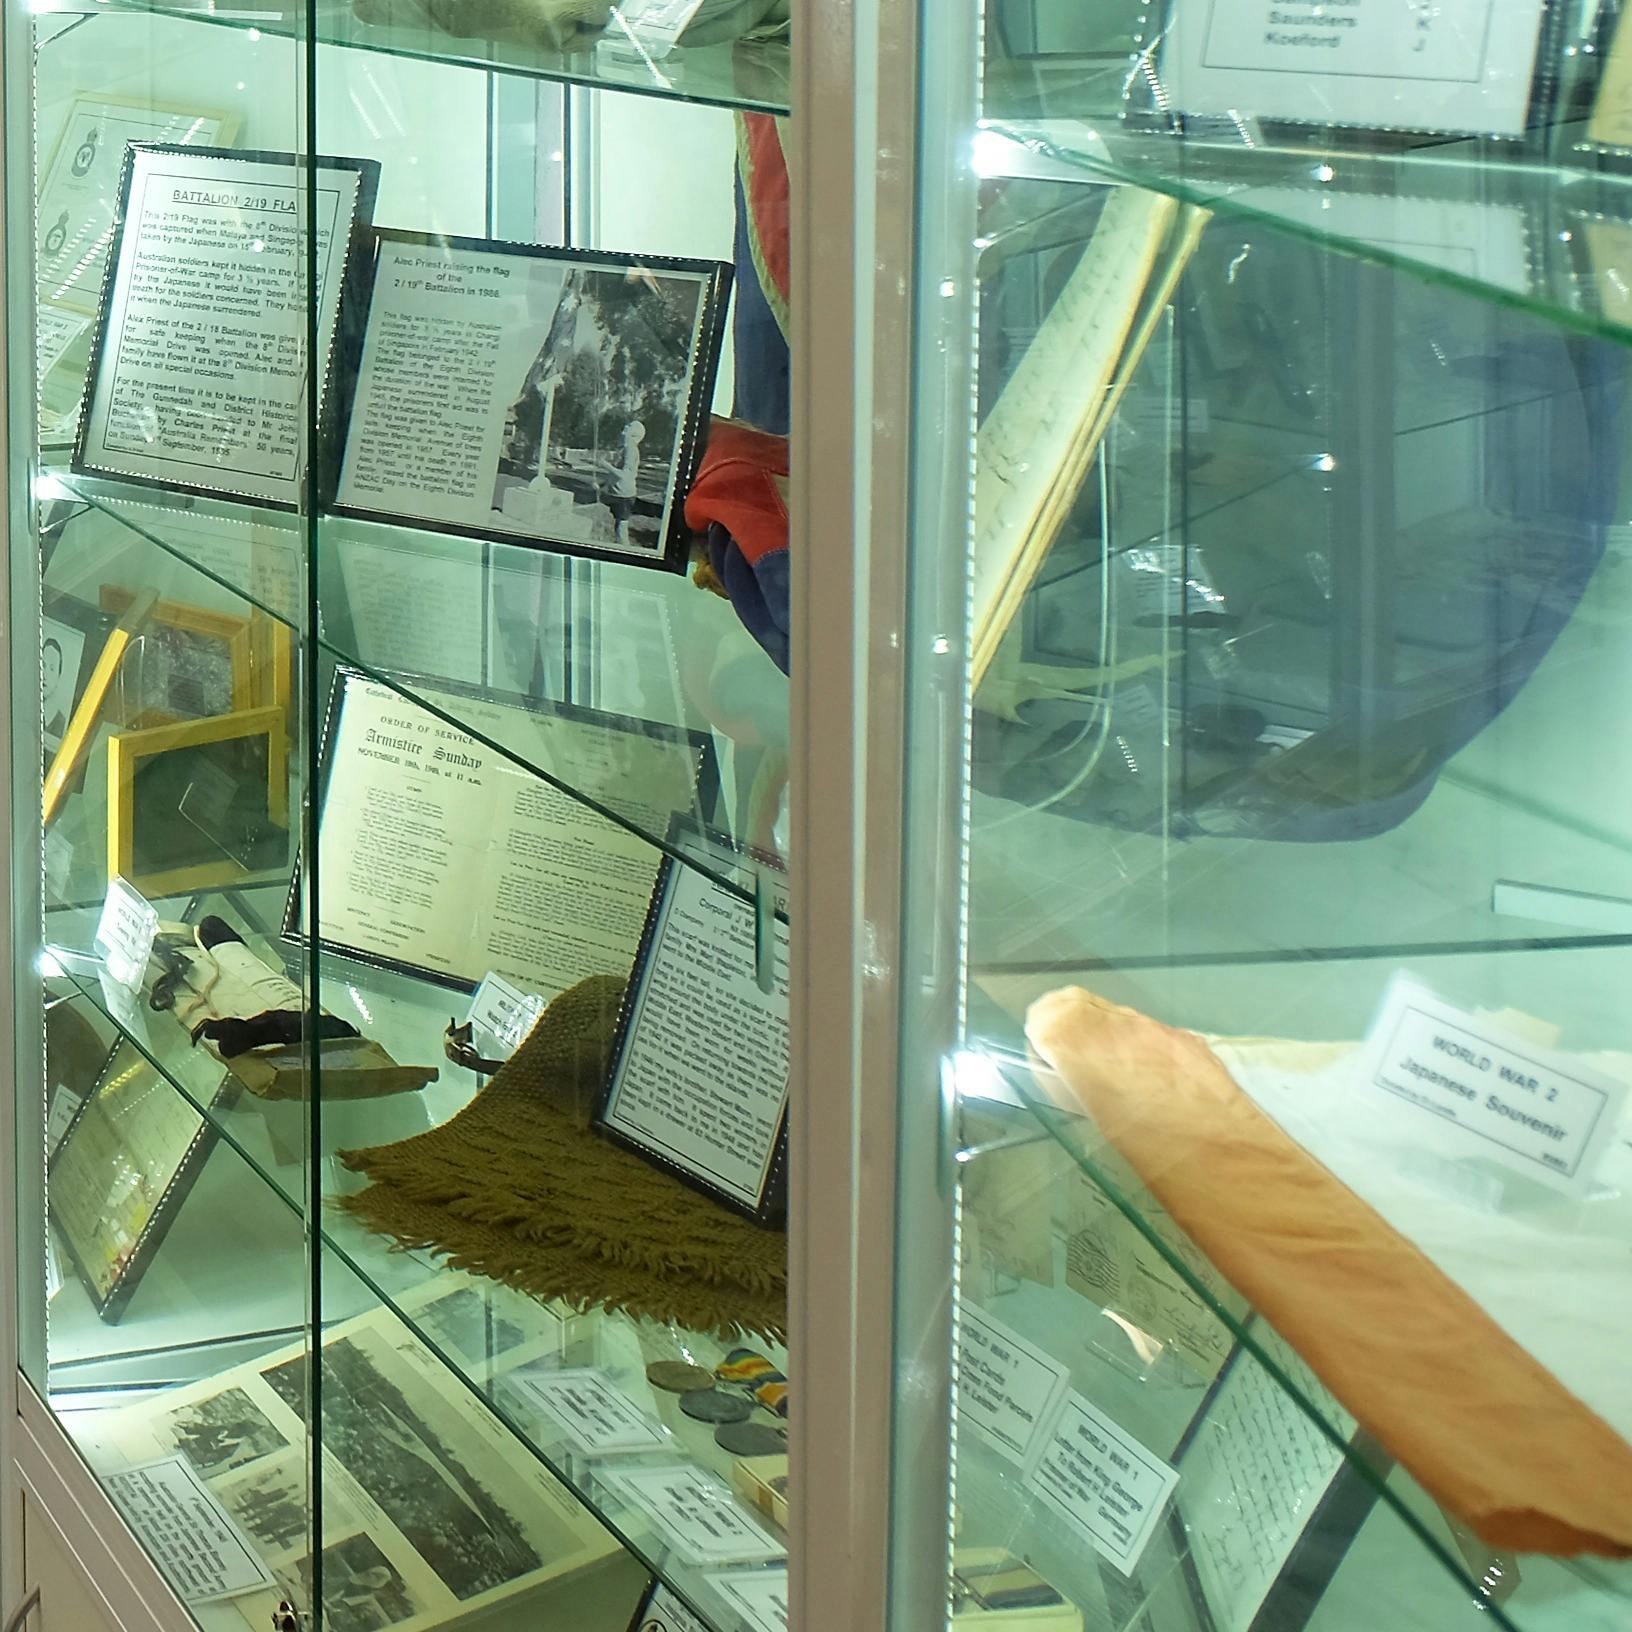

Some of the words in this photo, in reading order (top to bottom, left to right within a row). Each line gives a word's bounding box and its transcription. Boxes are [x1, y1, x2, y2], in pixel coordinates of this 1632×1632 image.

[1268, 11, 1358, 28] Saunders
[173, 190, 239, 206] BATTALION
[244, 197, 267, 209] 2/19
[273, 200, 296, 212] FLA
[415, 258, 441, 269] Priest
[444, 262, 474, 274] raising
[493, 266, 510, 277] flag
[424, 282, 465, 294] Battalion
[146, 380, 176, 394] present
[153, 393, 193, 406] Gunnedah
[224, 402, 254, 415] District
[380, 716, 413, 730] ORDER
[435, 729, 476, 746] SERVICE
[357, 747, 400, 764] NOVEMBER
[366, 728, 423, 755] Armistice
[432, 746, 483, 772] Sunday
[1432, 1036, 1492, 1073] WORLD
[1498, 1065, 1540, 1093] WAR
[1545, 1087, 1559, 1103] 2
[1400, 1056, 1478, 1101] Japanese
[1485, 1095, 1568, 1142] Souvenir
[990, 1342, 1010, 1364] WAR
[1078, 1424, 1108, 1454] WORLD
[1109, 1451, 1130, 1473] WAR
[1076, 1450, 1092, 1470] from
[1094, 1465, 1111, 1487] King
[1112, 1481, 1143, 1512] George
